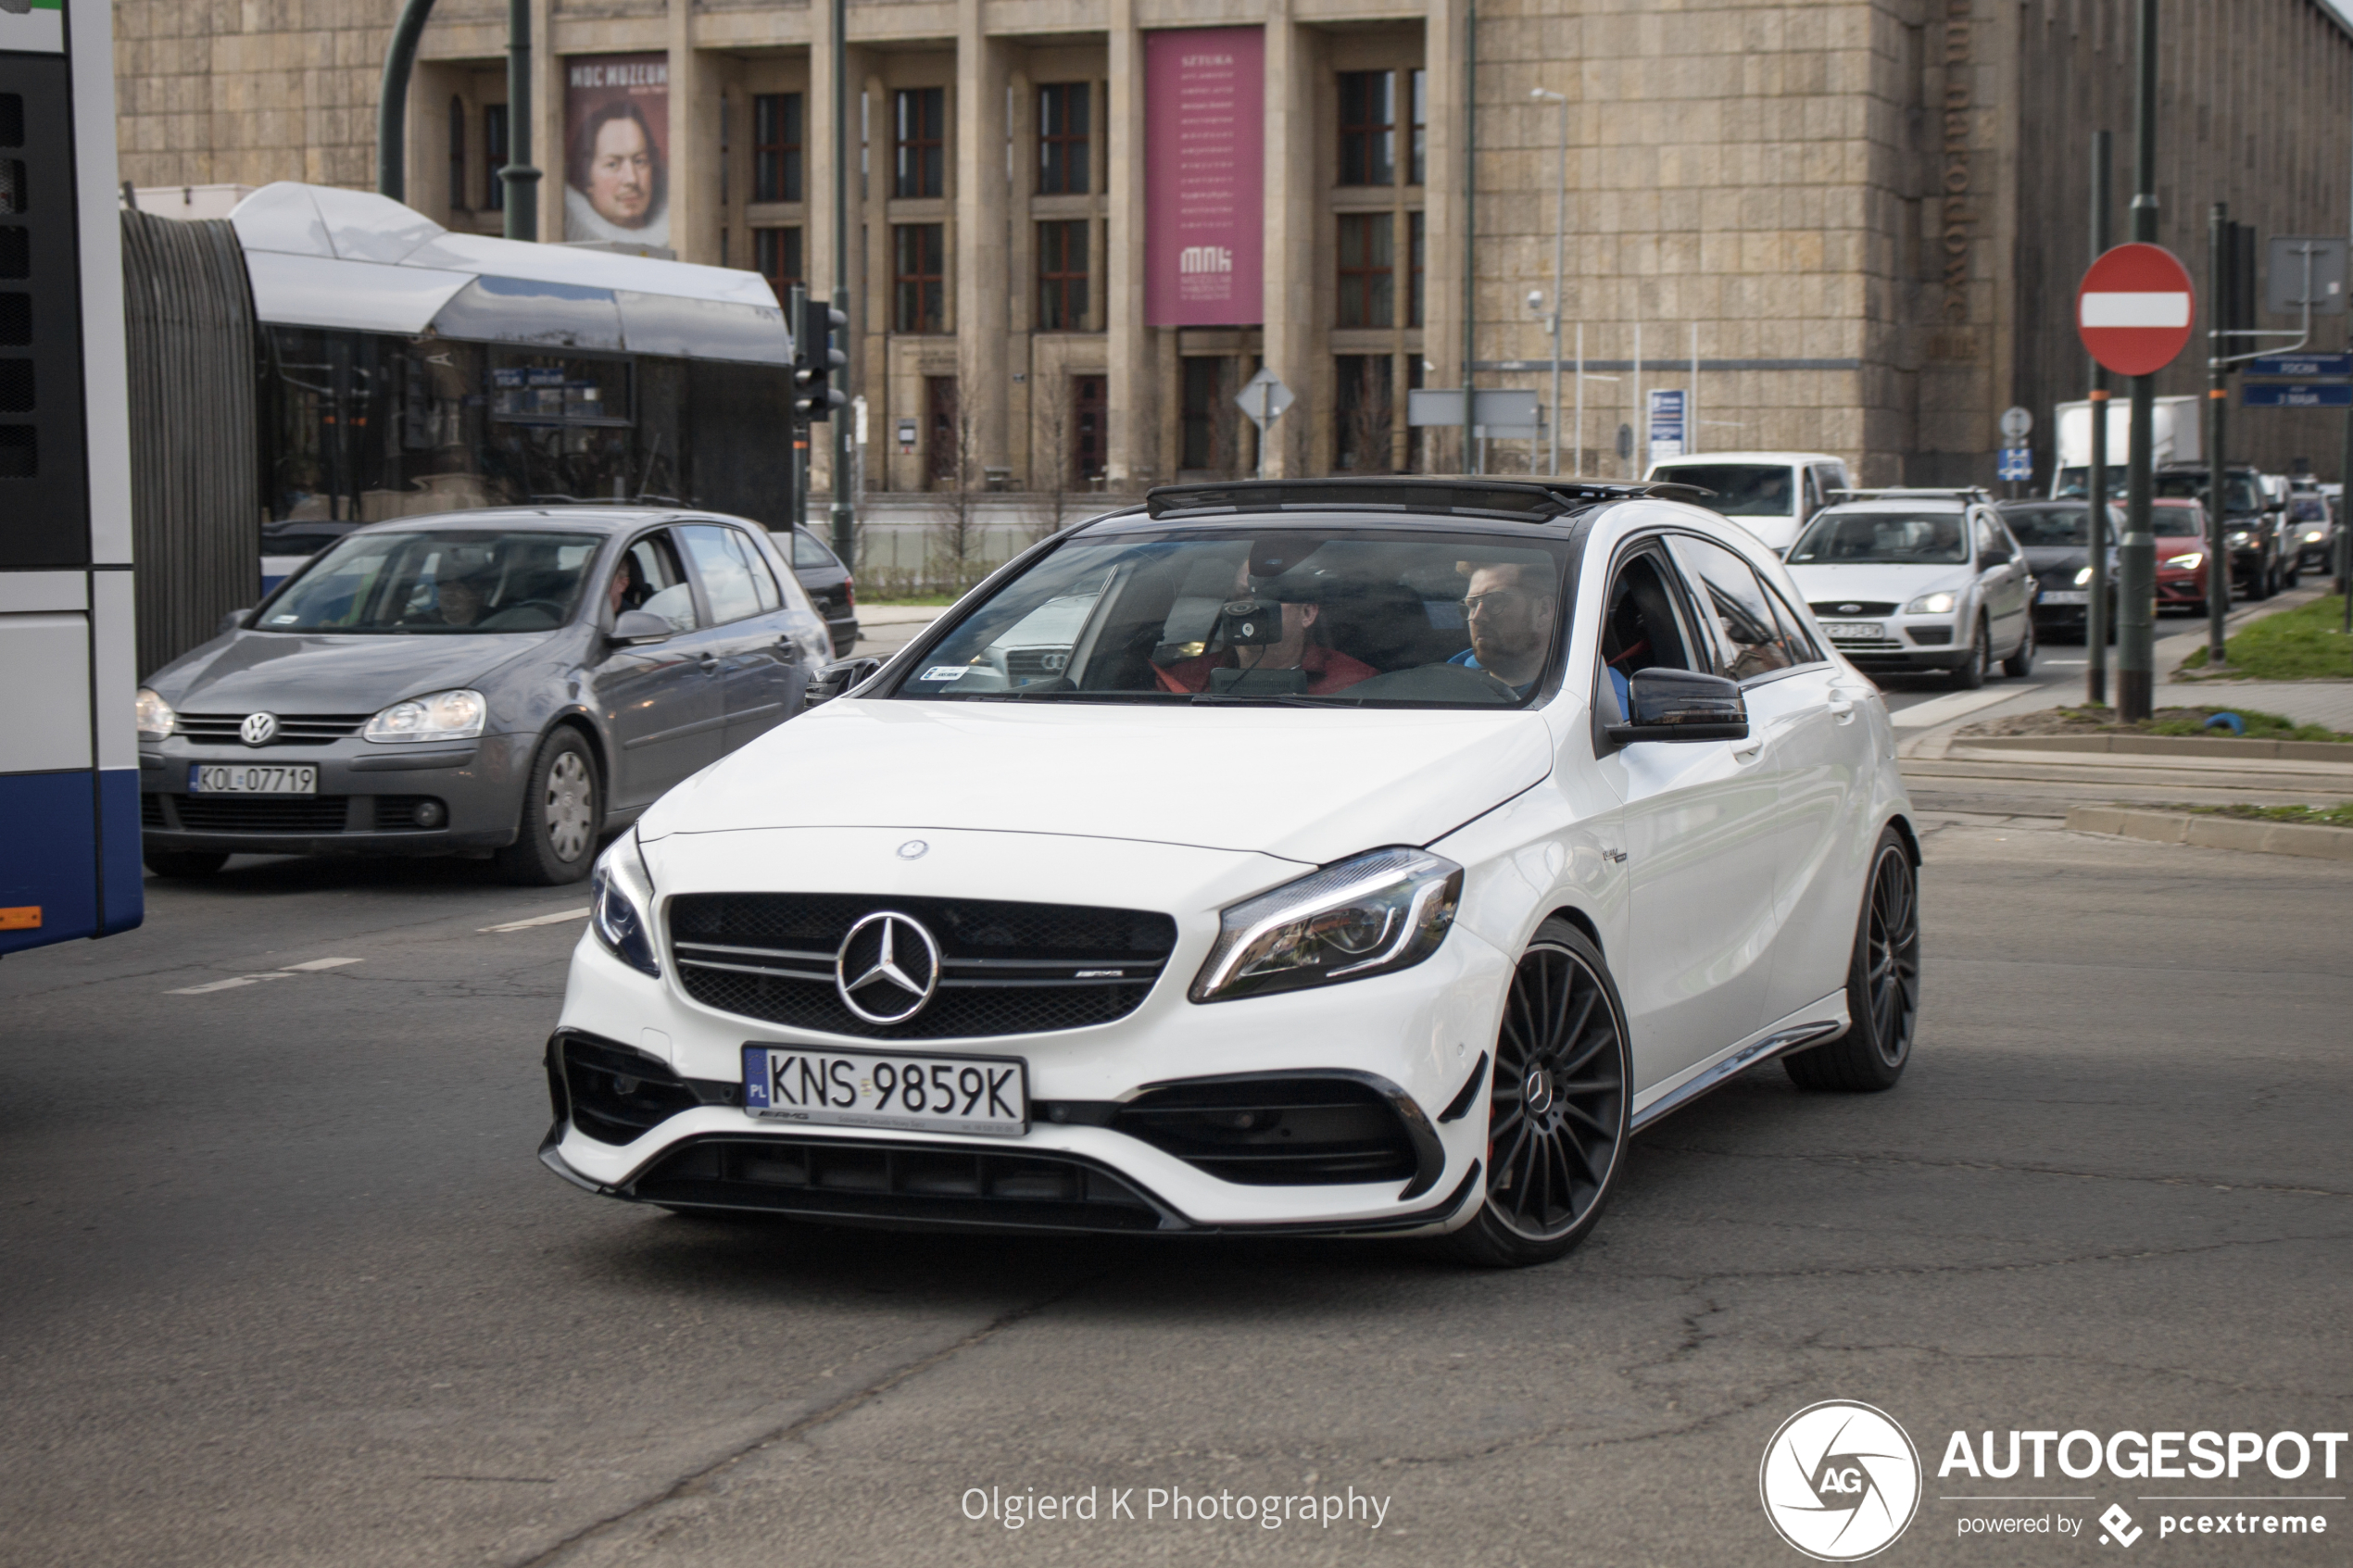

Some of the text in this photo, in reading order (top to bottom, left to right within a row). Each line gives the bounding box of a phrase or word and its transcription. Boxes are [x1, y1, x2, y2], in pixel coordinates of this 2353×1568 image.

[199, 768, 313, 792] KOL 07719
[749, 1085, 767, 1098] PL
[771, 1055, 1017, 1119] KNS 9859K
